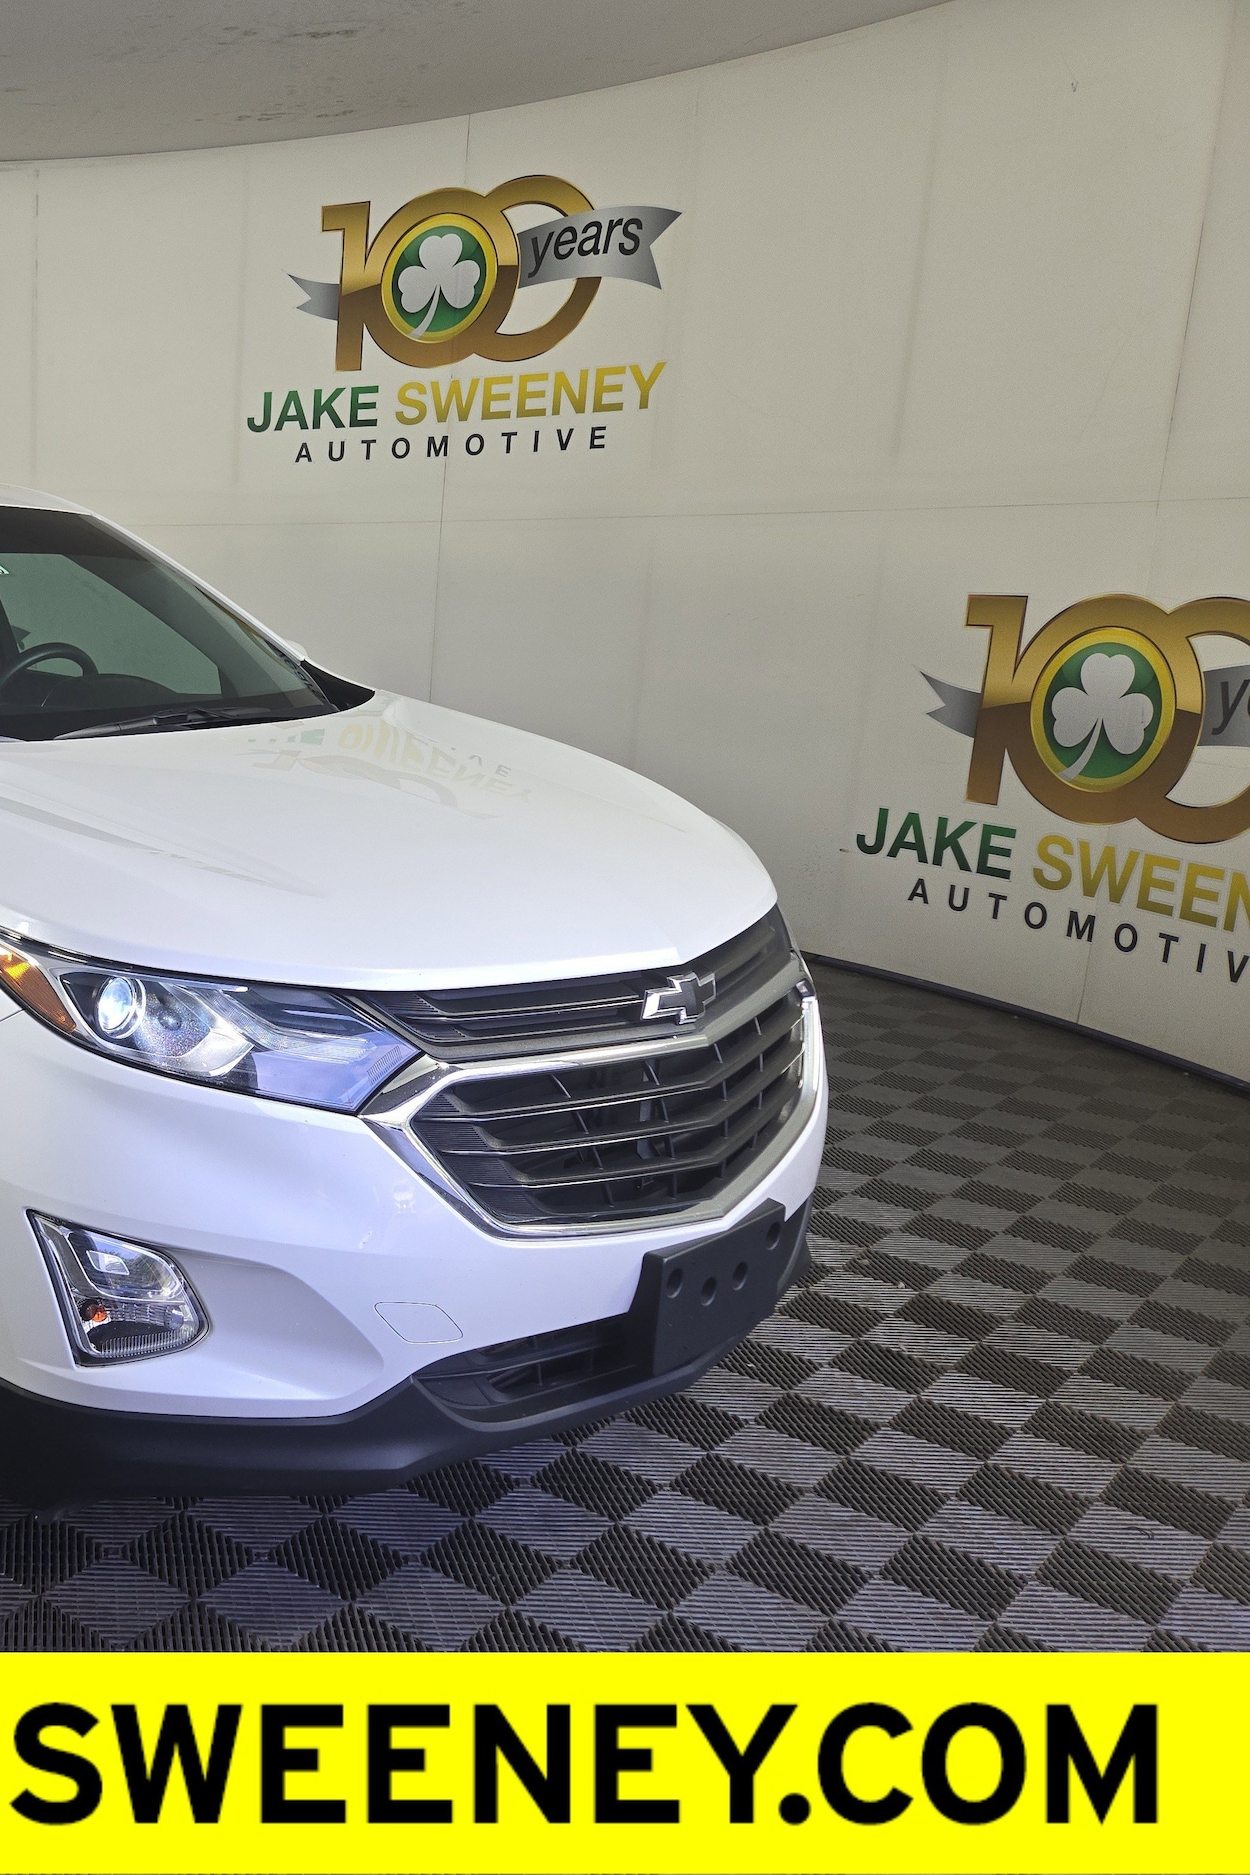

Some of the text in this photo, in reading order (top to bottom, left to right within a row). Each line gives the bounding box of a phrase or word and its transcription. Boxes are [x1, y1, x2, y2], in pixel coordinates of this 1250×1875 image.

[321, 174, 605, 373] 100
[527, 216, 644, 280] years
[246, 361, 668, 434] JAKE SWEENEY
[294, 425, 608, 465] AUTOMOTIVE
[855, 807, 1018, 881] JAKE
[907, 877, 1250, 984] AUTOMOTIV
